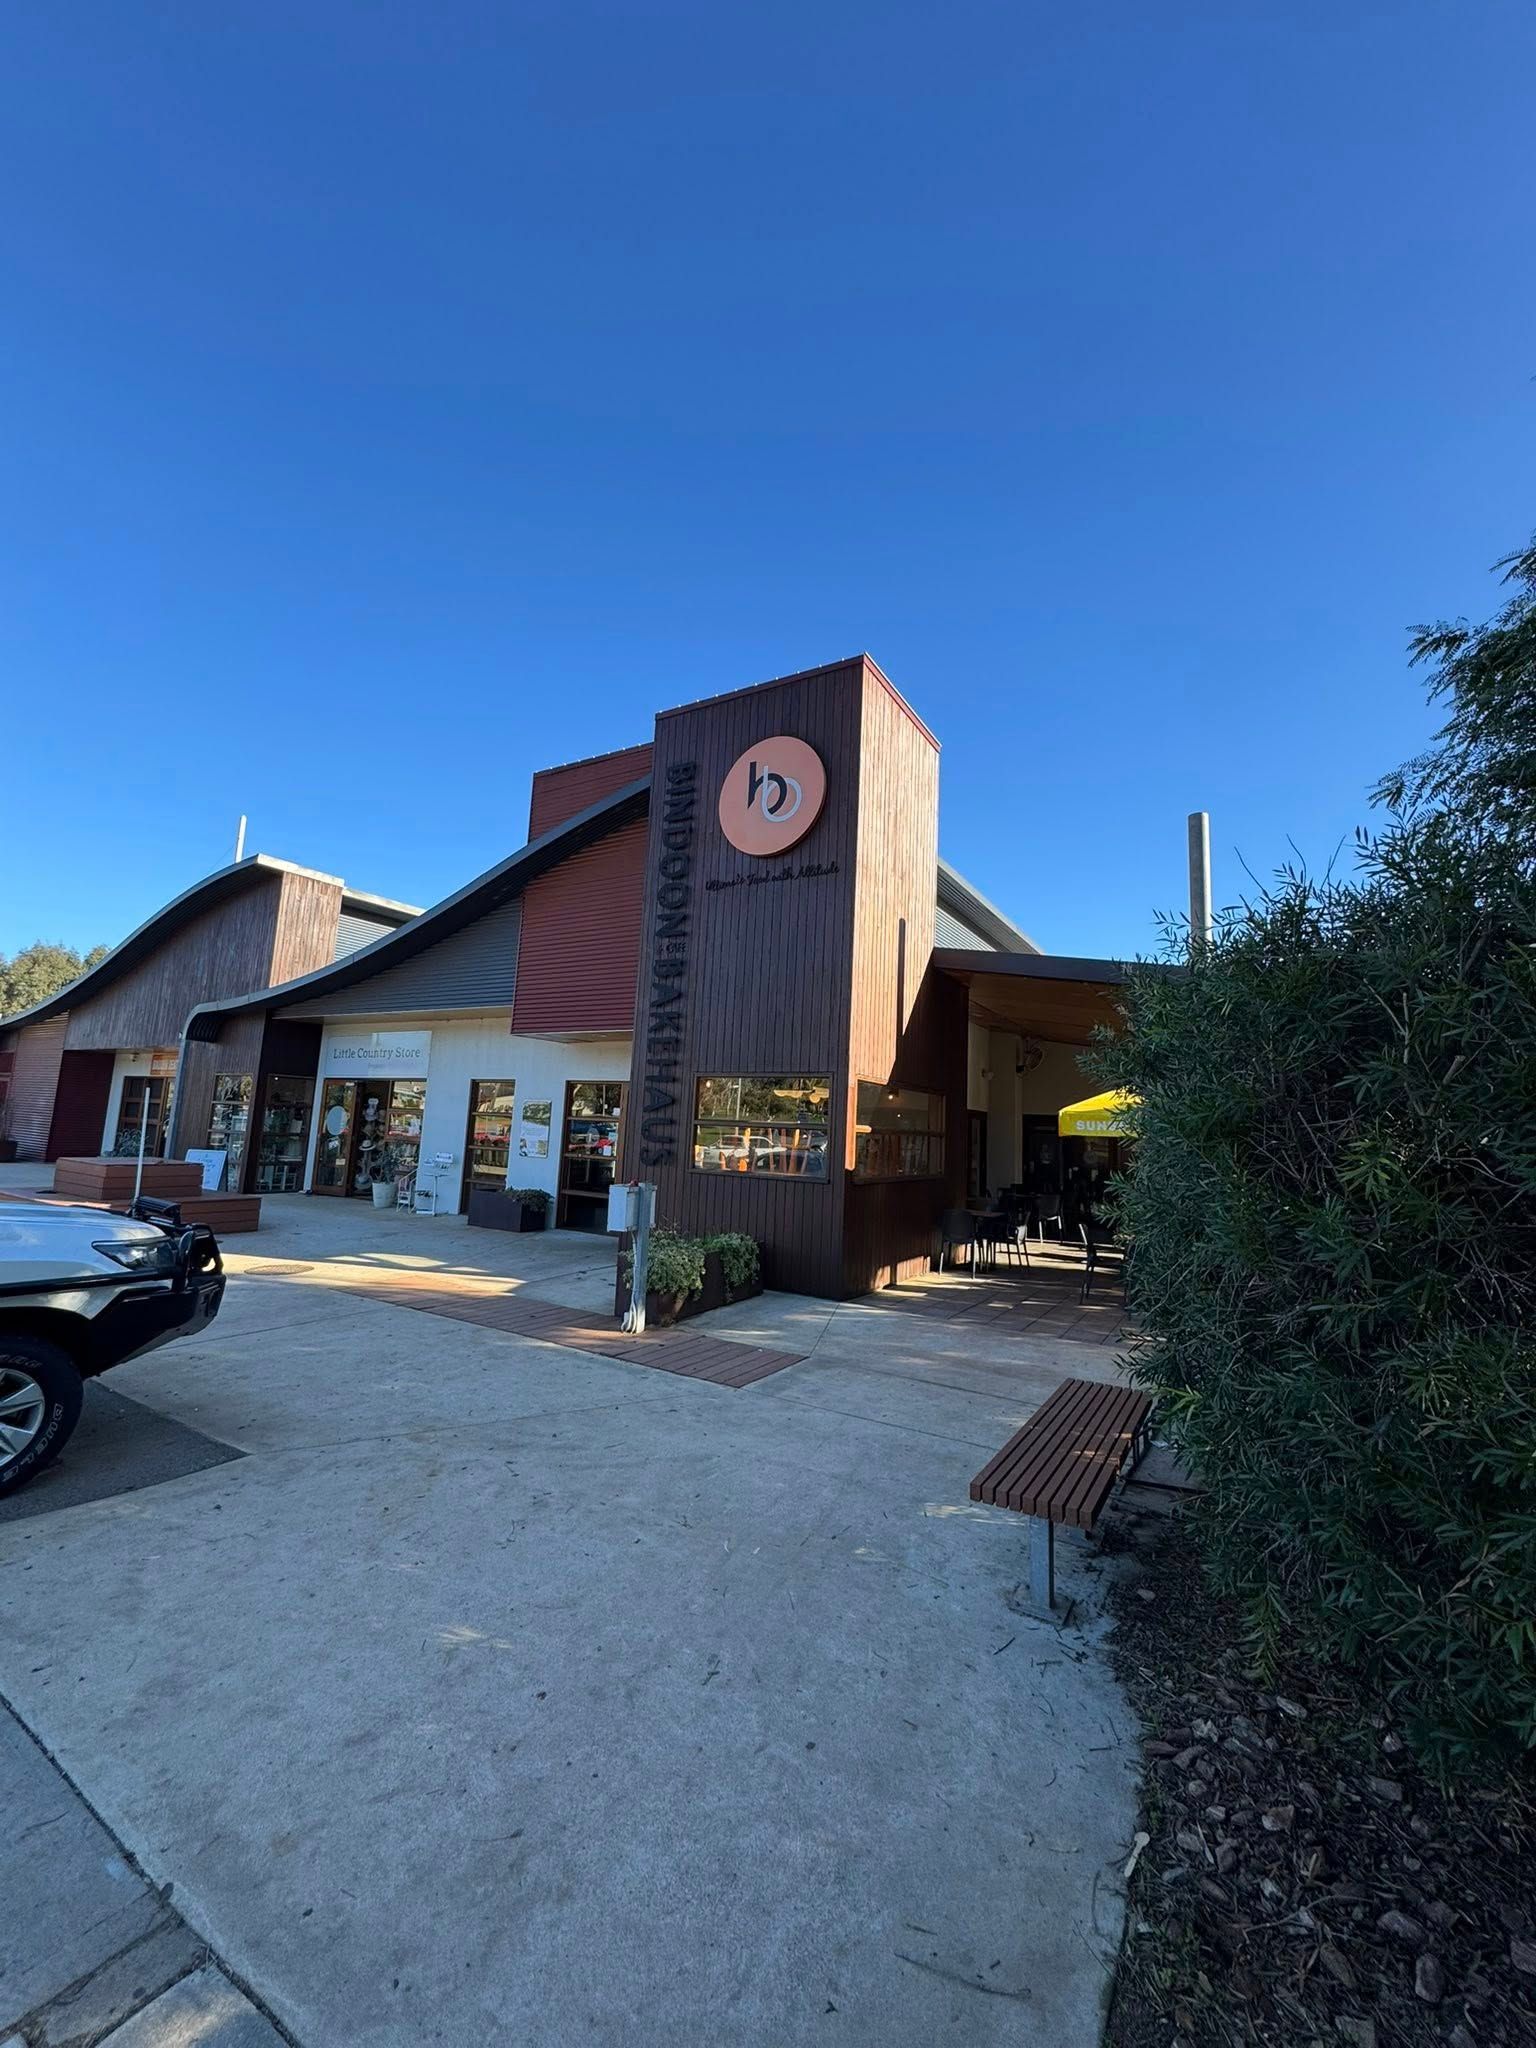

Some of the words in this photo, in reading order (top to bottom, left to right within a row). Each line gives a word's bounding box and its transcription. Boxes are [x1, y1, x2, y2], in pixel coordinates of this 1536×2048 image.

[655, 762, 697, 939] BINDOON
[746, 870, 771, 886] Food
[771, 866, 796, 882] with
[796, 860, 840, 880] Attitude
[333, 1047, 356, 1059] Little
[357, 1047, 394, 1060] Country
[395, 1046, 420, 1058] Store
[639, 959, 685, 1167] BAKEHAUS
